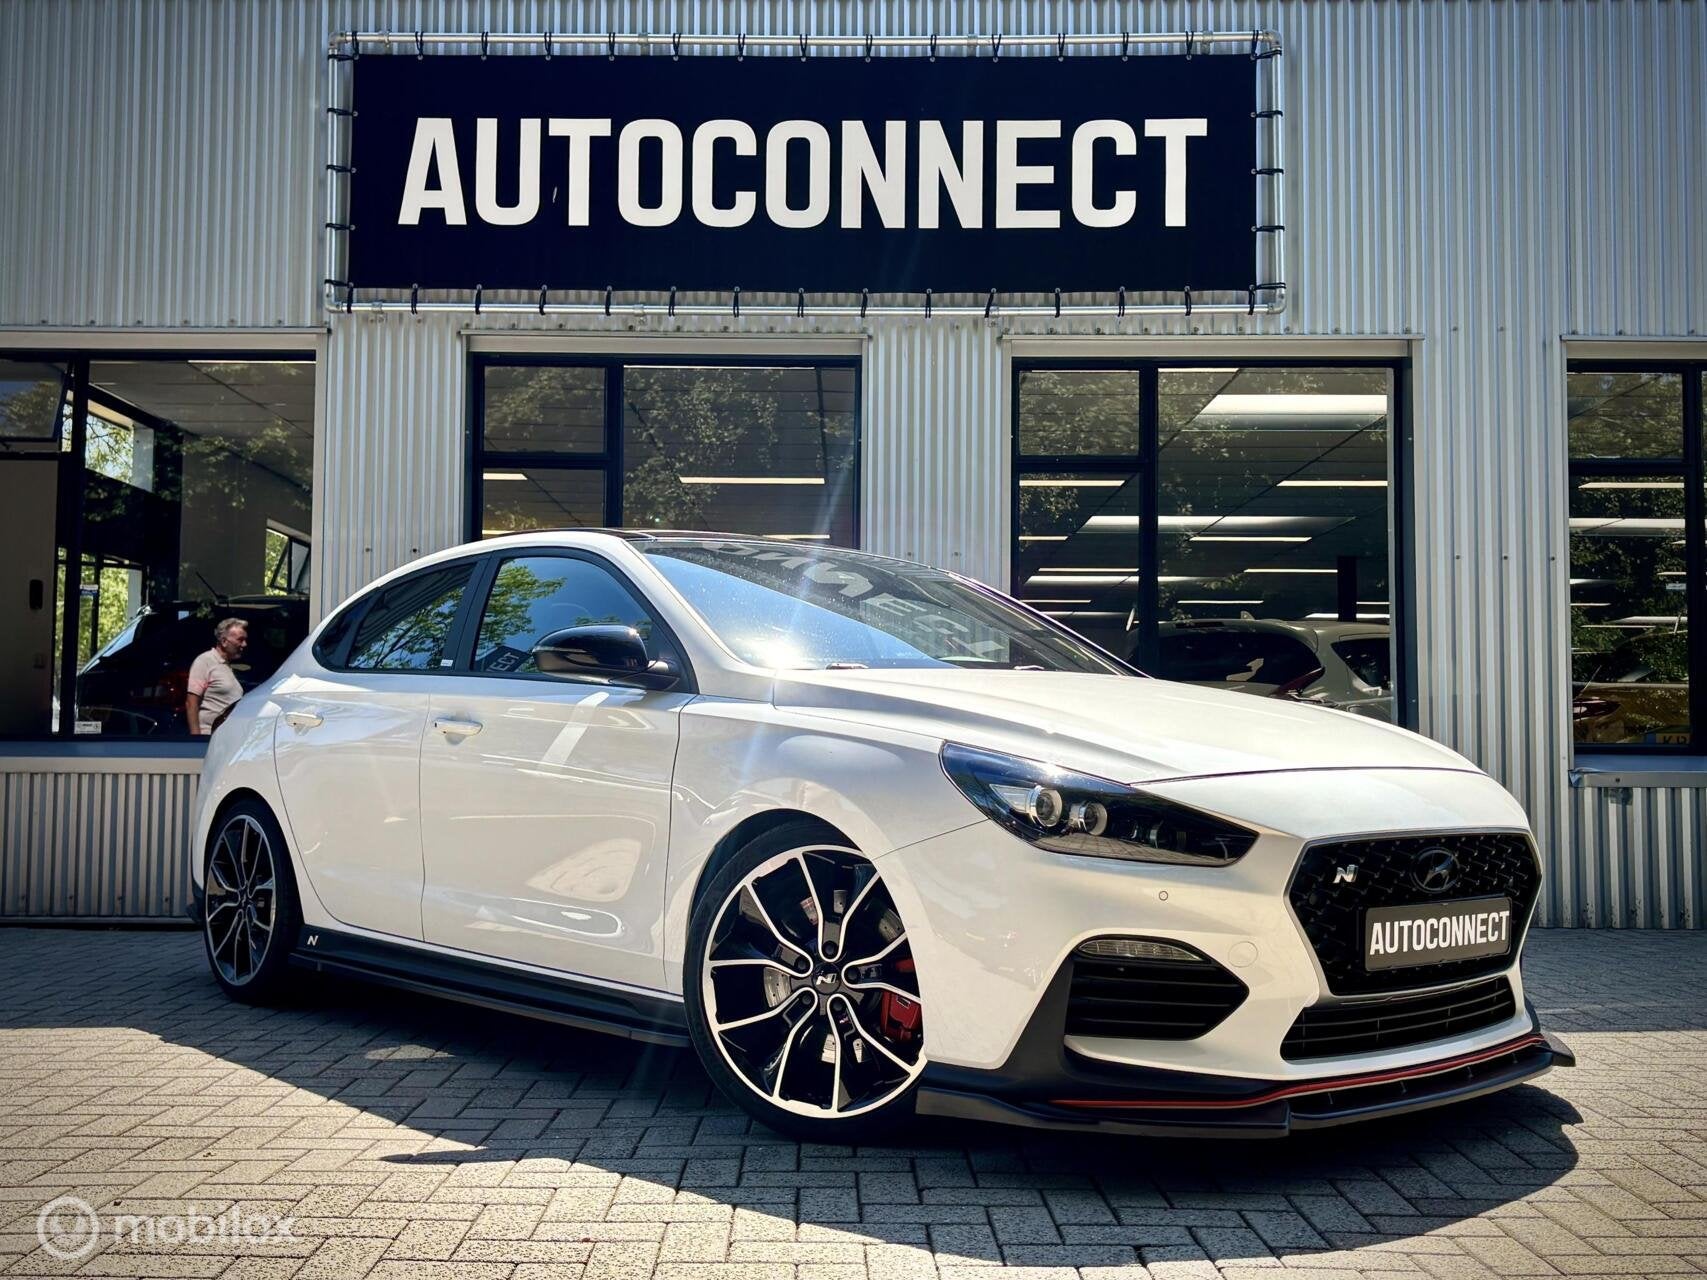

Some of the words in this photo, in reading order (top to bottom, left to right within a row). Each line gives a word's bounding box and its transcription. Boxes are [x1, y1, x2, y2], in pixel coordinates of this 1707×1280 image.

[398, 117, 1208, 229] AUTOCONNECT
[307, 935, 318, 946] N
[1369, 910, 1510, 956] AUTOCONNECT
